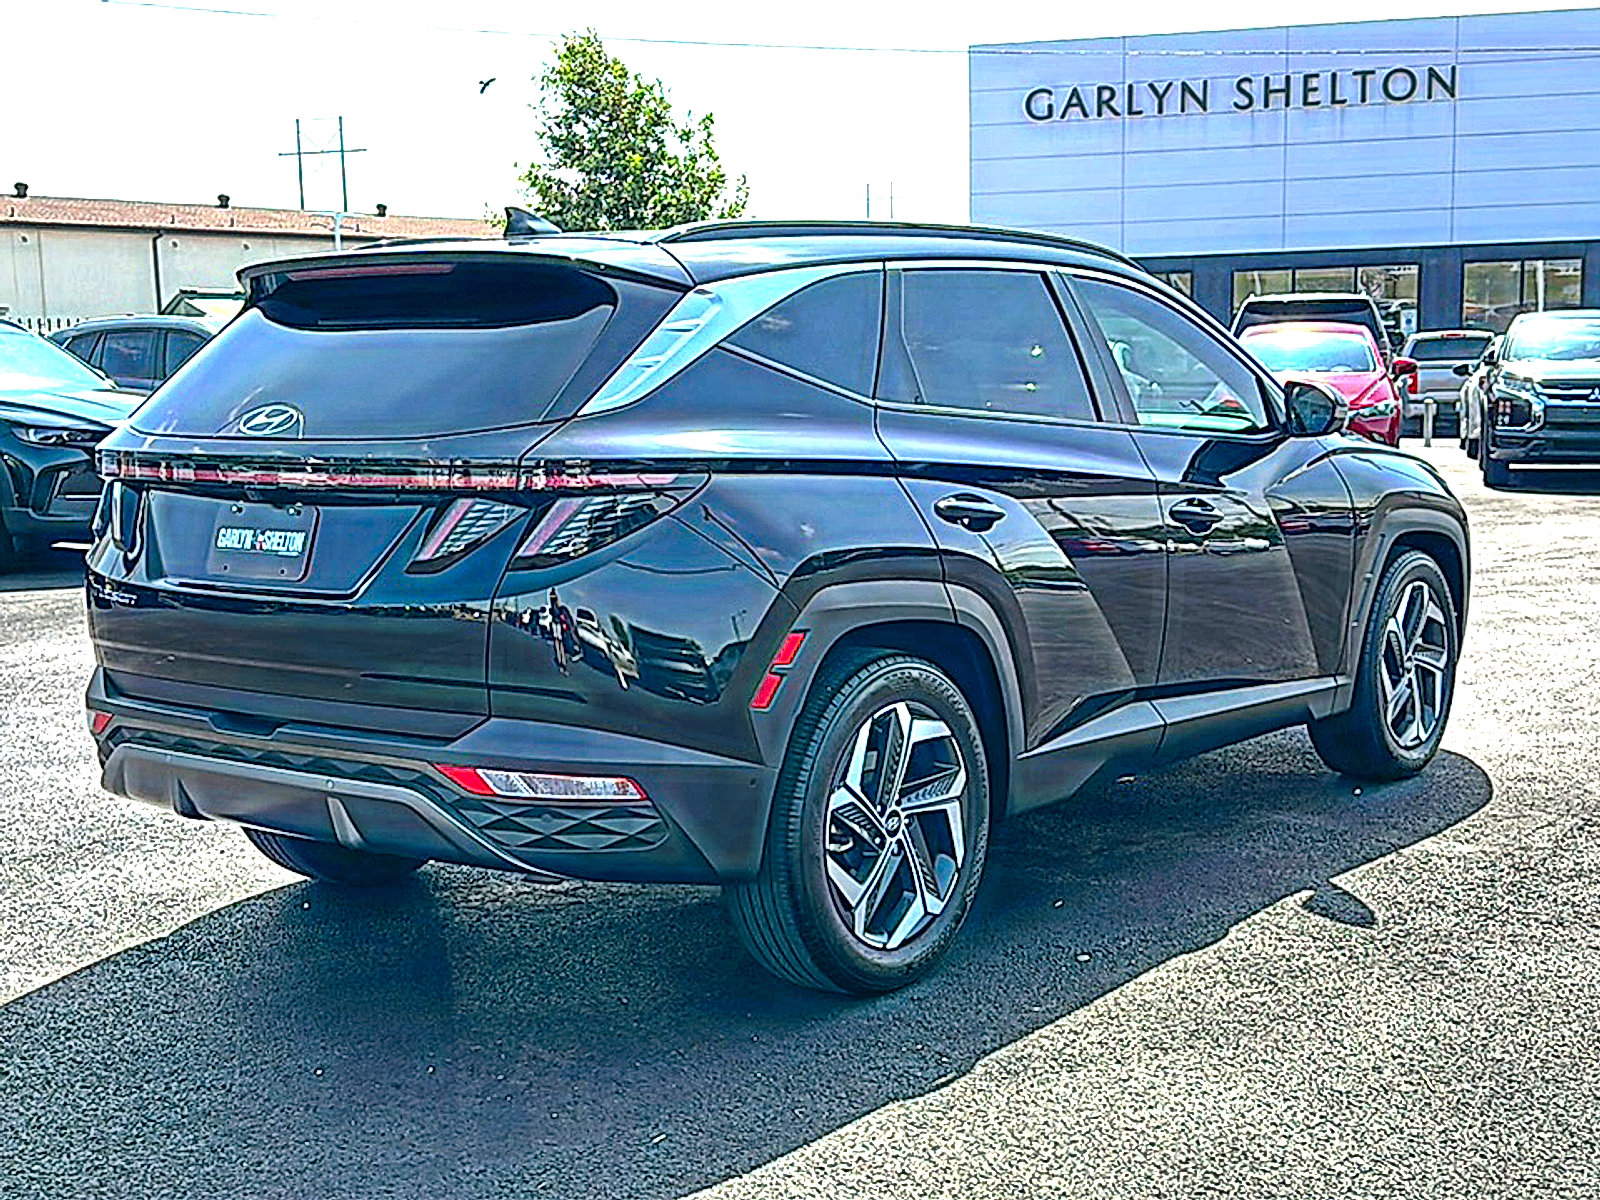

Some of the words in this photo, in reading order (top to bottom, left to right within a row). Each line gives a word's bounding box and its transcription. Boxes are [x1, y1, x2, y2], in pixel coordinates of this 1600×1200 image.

[1025, 79, 1208, 121] GARLYN
[1232, 65, 1457, 110] SHELTON
[263, 530, 306, 552] SHELTON
